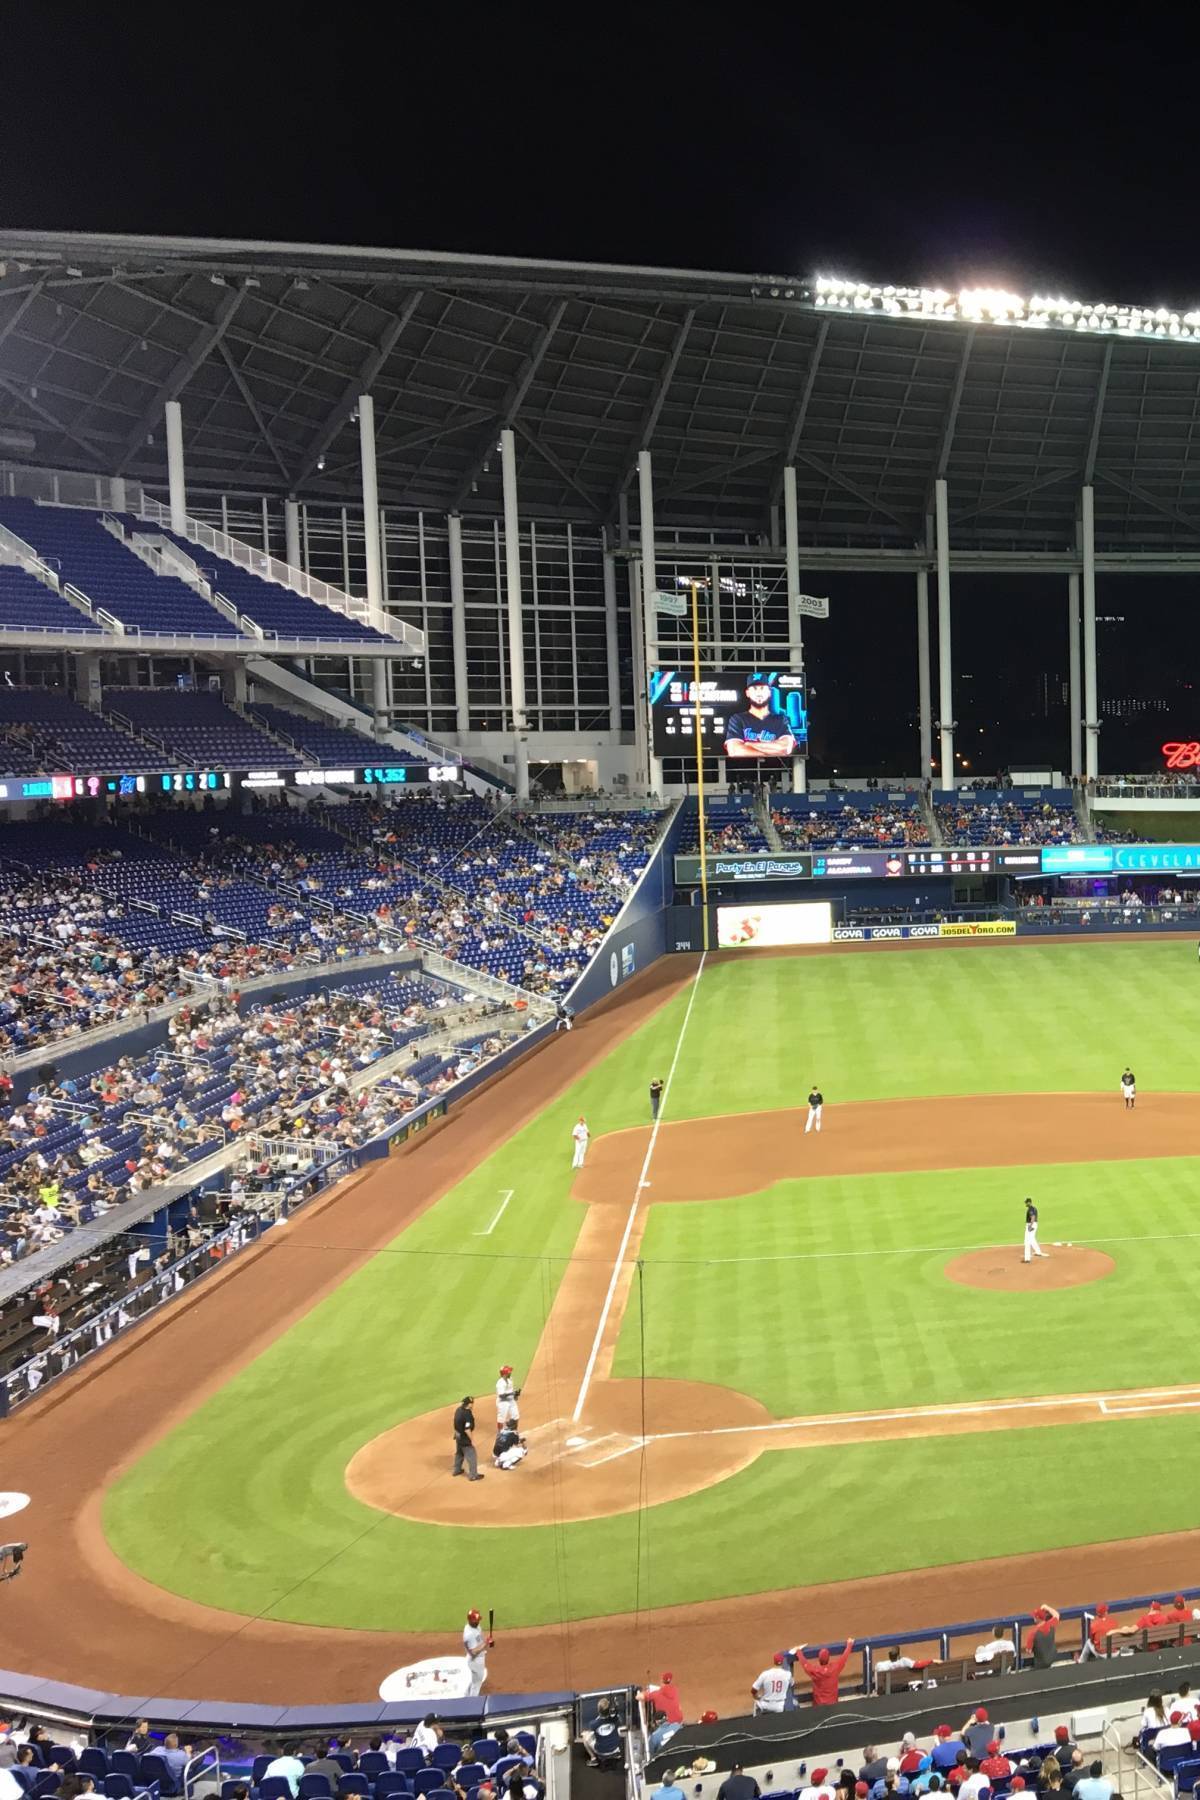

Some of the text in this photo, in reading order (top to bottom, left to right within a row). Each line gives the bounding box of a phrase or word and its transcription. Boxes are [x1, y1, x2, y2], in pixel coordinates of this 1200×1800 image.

[801, 597, 823, 607] 2003
[173, 774, 182, 790] 2
[199, 773, 207, 789] 2
[223, 773, 230, 788] 1
[716, 860, 802, 876] Party En El Parque
[834, 928, 863, 940] GOYA
[872, 927, 901, 938] GOYA
[910, 926, 938, 936] GOYA
[675, 941, 690, 950] 344
[771, 1680, 783, 1693] 19
